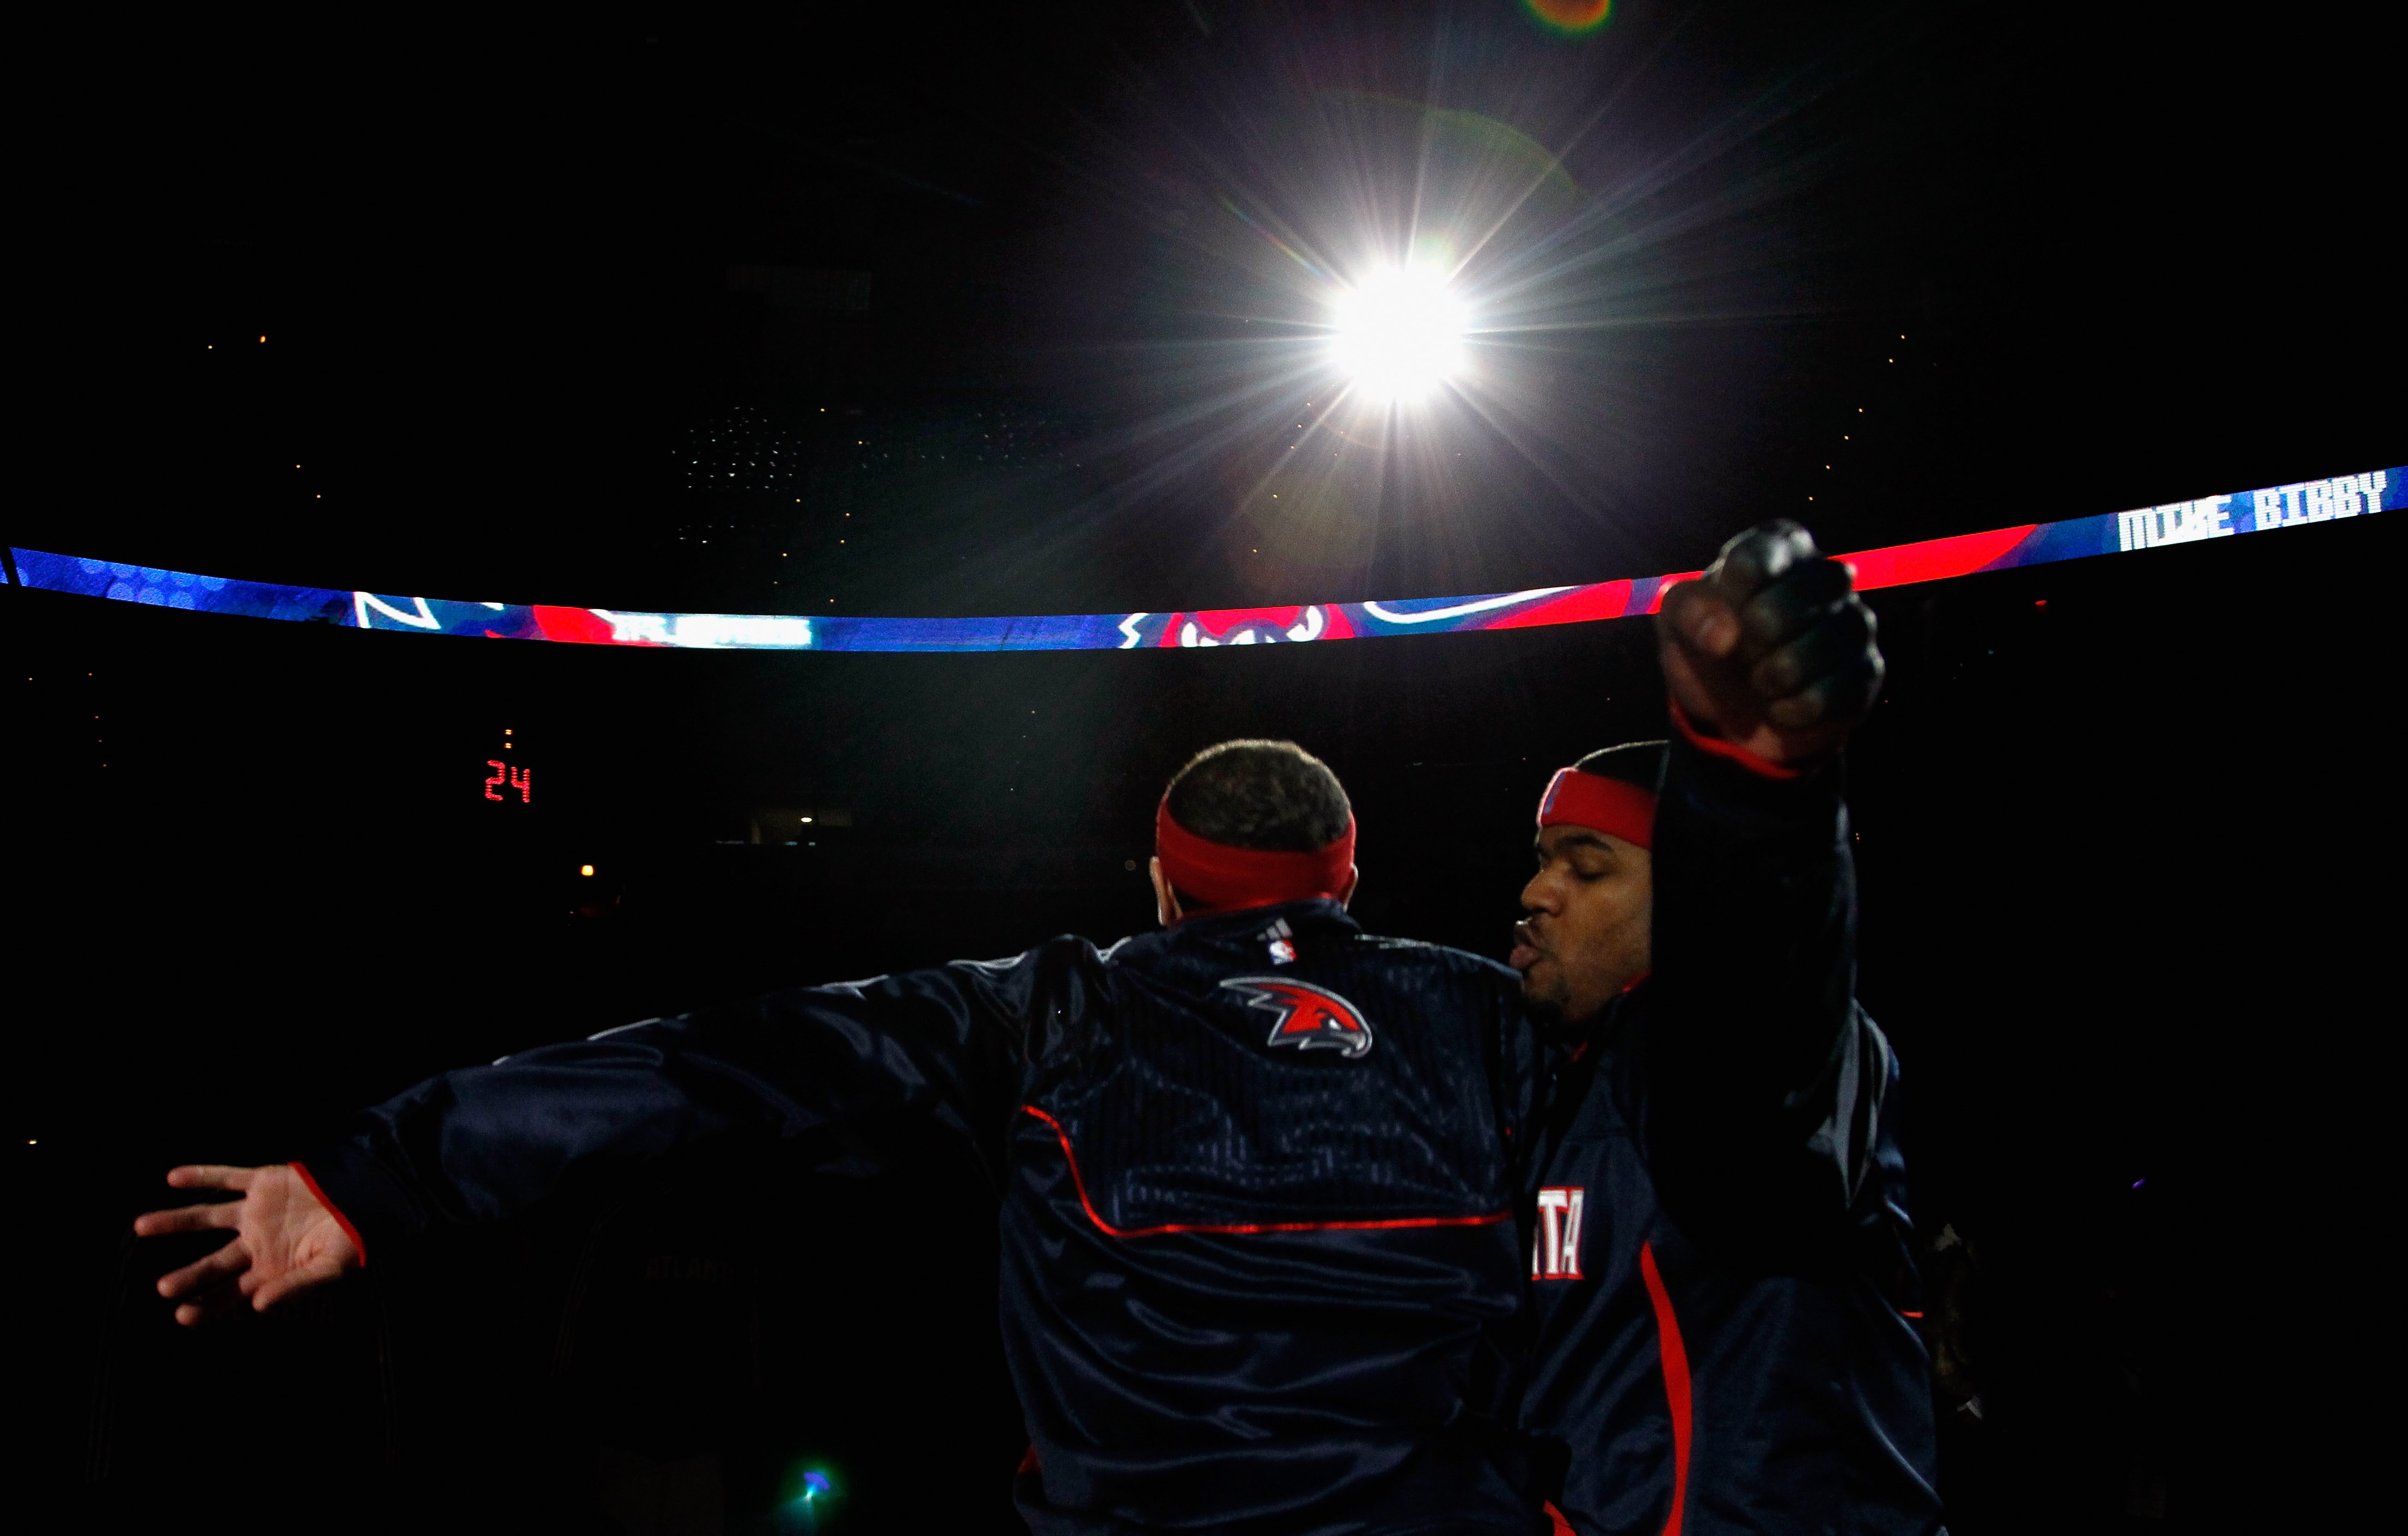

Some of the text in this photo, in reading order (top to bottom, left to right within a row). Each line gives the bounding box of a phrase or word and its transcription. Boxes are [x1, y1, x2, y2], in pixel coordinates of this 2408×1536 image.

[2118, 470, 2387, 552] MIKE BIBBY
[485, 759, 531, 803] 24
